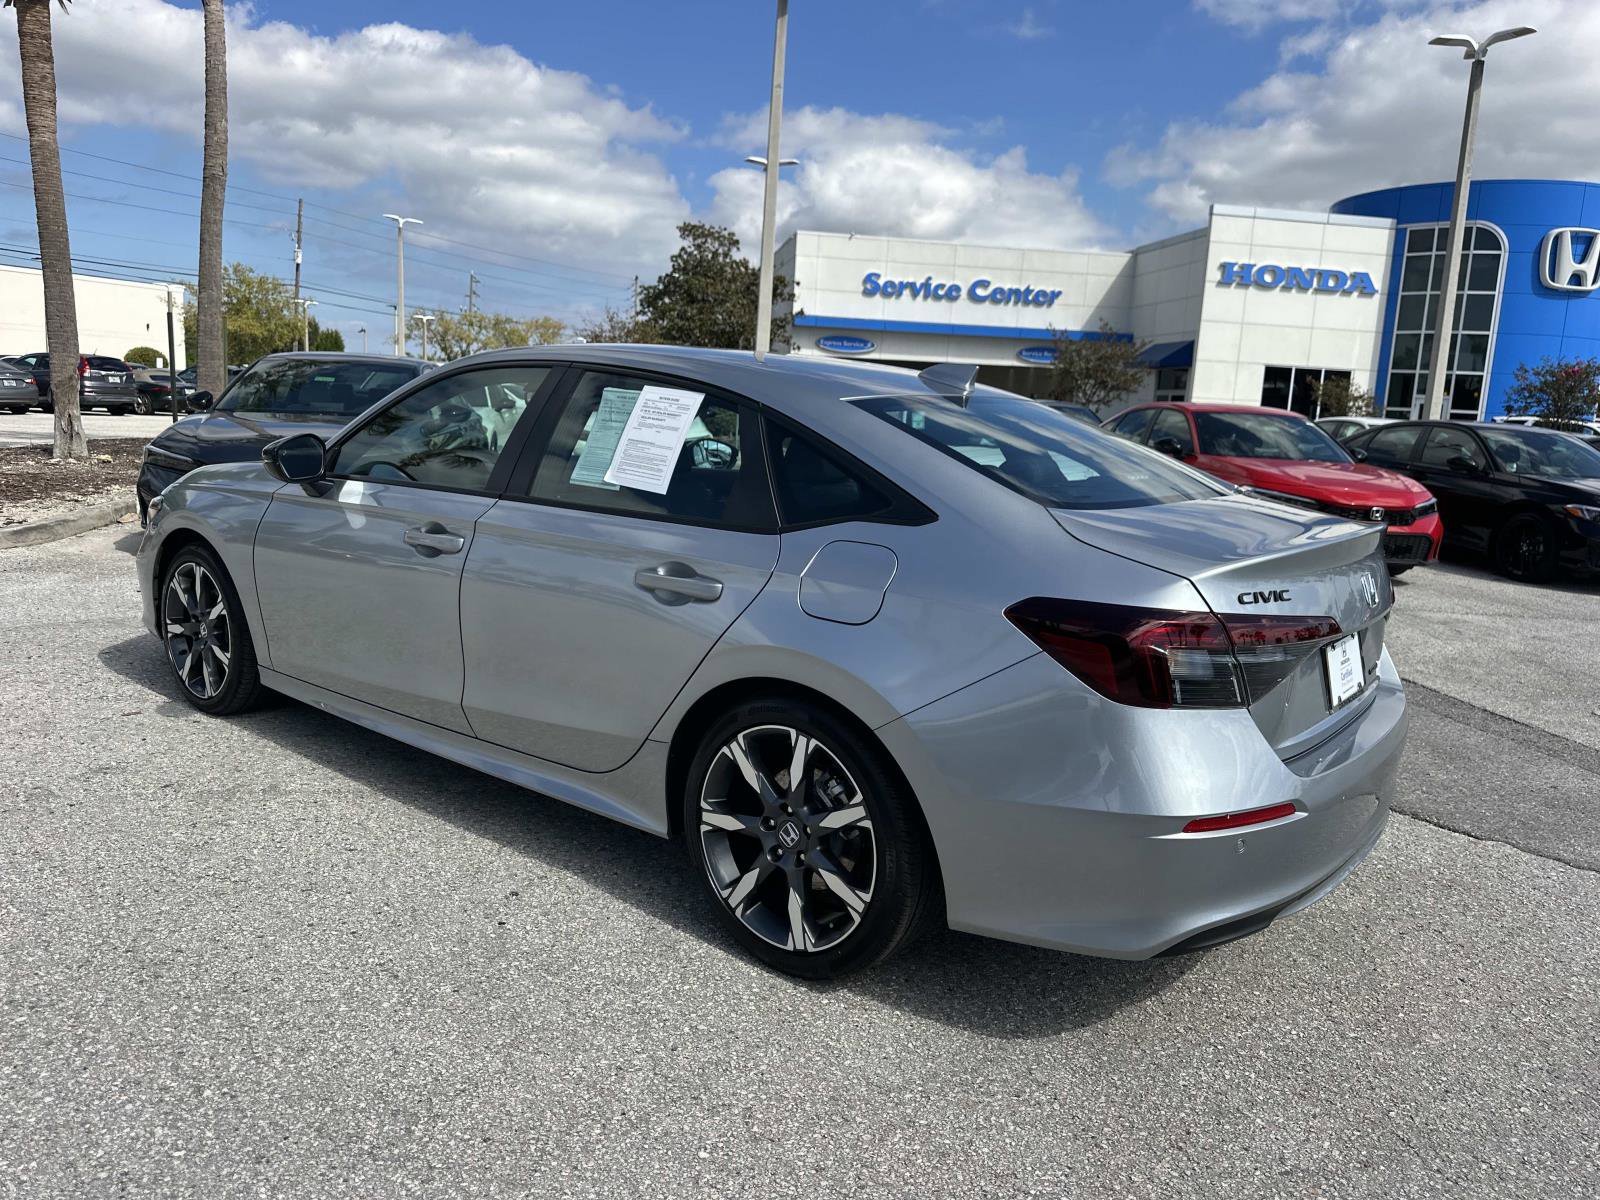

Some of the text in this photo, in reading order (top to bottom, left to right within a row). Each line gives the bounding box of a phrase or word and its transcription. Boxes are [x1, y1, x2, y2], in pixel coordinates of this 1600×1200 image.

[862, 272, 1062, 307] Service Center
[1217, 261, 1378, 298] HONDA
[1237, 589, 1292, 605] CIVIC
